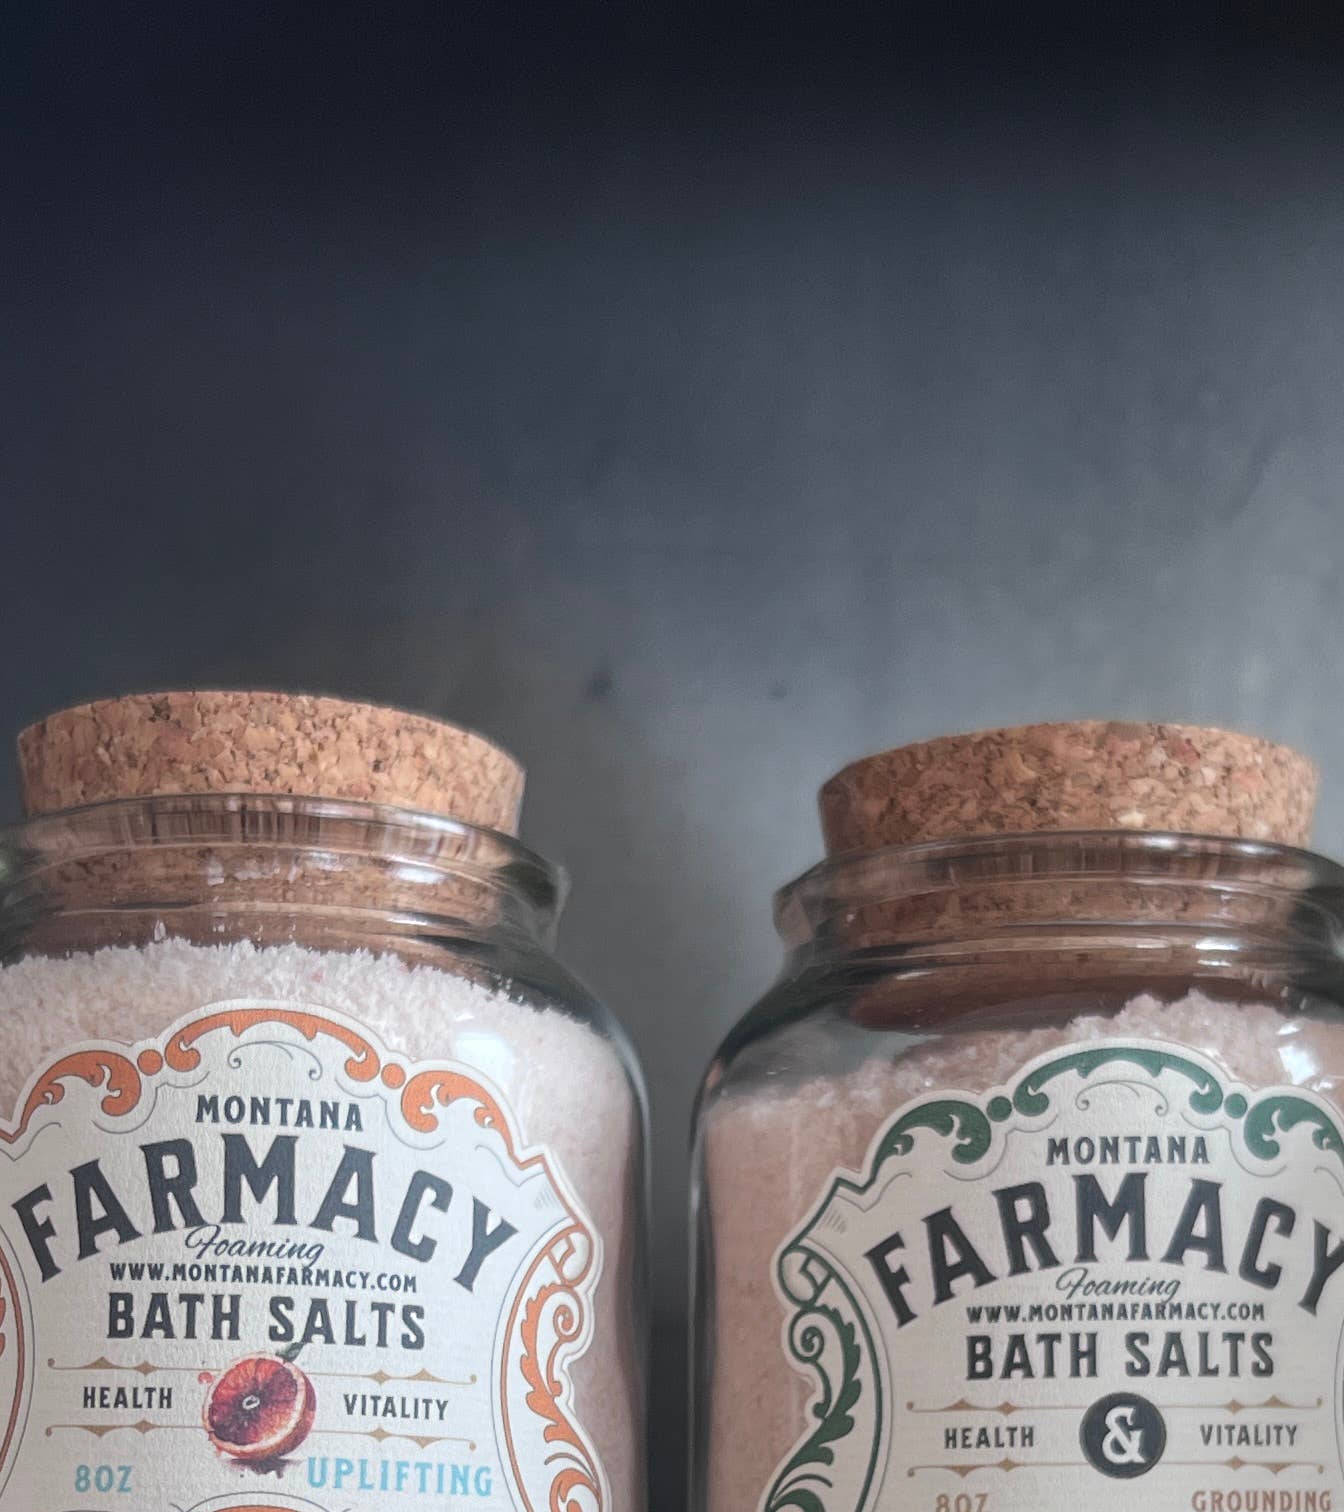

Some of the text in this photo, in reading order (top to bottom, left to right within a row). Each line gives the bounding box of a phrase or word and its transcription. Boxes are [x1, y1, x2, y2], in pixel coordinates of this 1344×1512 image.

[195, 1094, 363, 1132] MONTANA
[1046, 1135, 1210, 1166] MONTANA
[10, 1132, 518, 1292] FARMACY
[185, 1224, 325, 1266] Foaming
[110, 1261, 417, 1293] WWW.MONTANAFARMACY.COM
[1056, 1267, 1181, 1303] Foaming
[107, 1292, 426, 1350] BATH SALTS
[966, 1302, 1265, 1324] WWW.MONTANAFARMACY.COM
[966, 1331, 1274, 1380] BATH SALTS
[83, 1385, 450, 1421] HEALTH VITALITY
[944, 1406, 1298, 1464] HEALTH & VITALITY
[74, 1456, 493, 1497] 8OZ UPLIFTING
